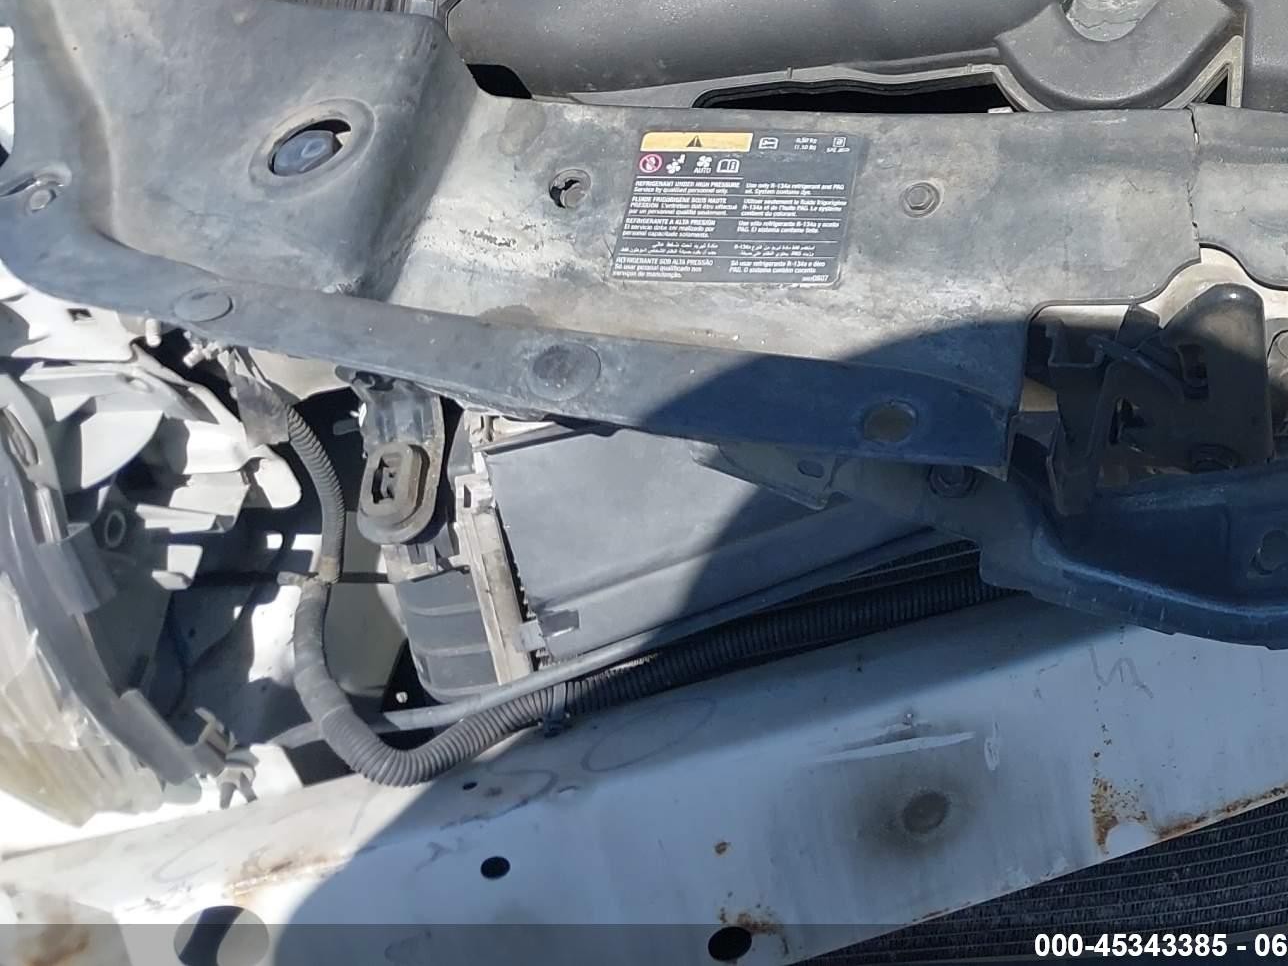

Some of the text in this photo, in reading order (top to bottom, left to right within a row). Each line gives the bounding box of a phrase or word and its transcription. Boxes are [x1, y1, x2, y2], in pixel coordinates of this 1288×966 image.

[615, 256, 659, 265] REFRIGERANTE
[659, 257, 671, 265] SOB
[671, 257, 686, 265] ALTA
